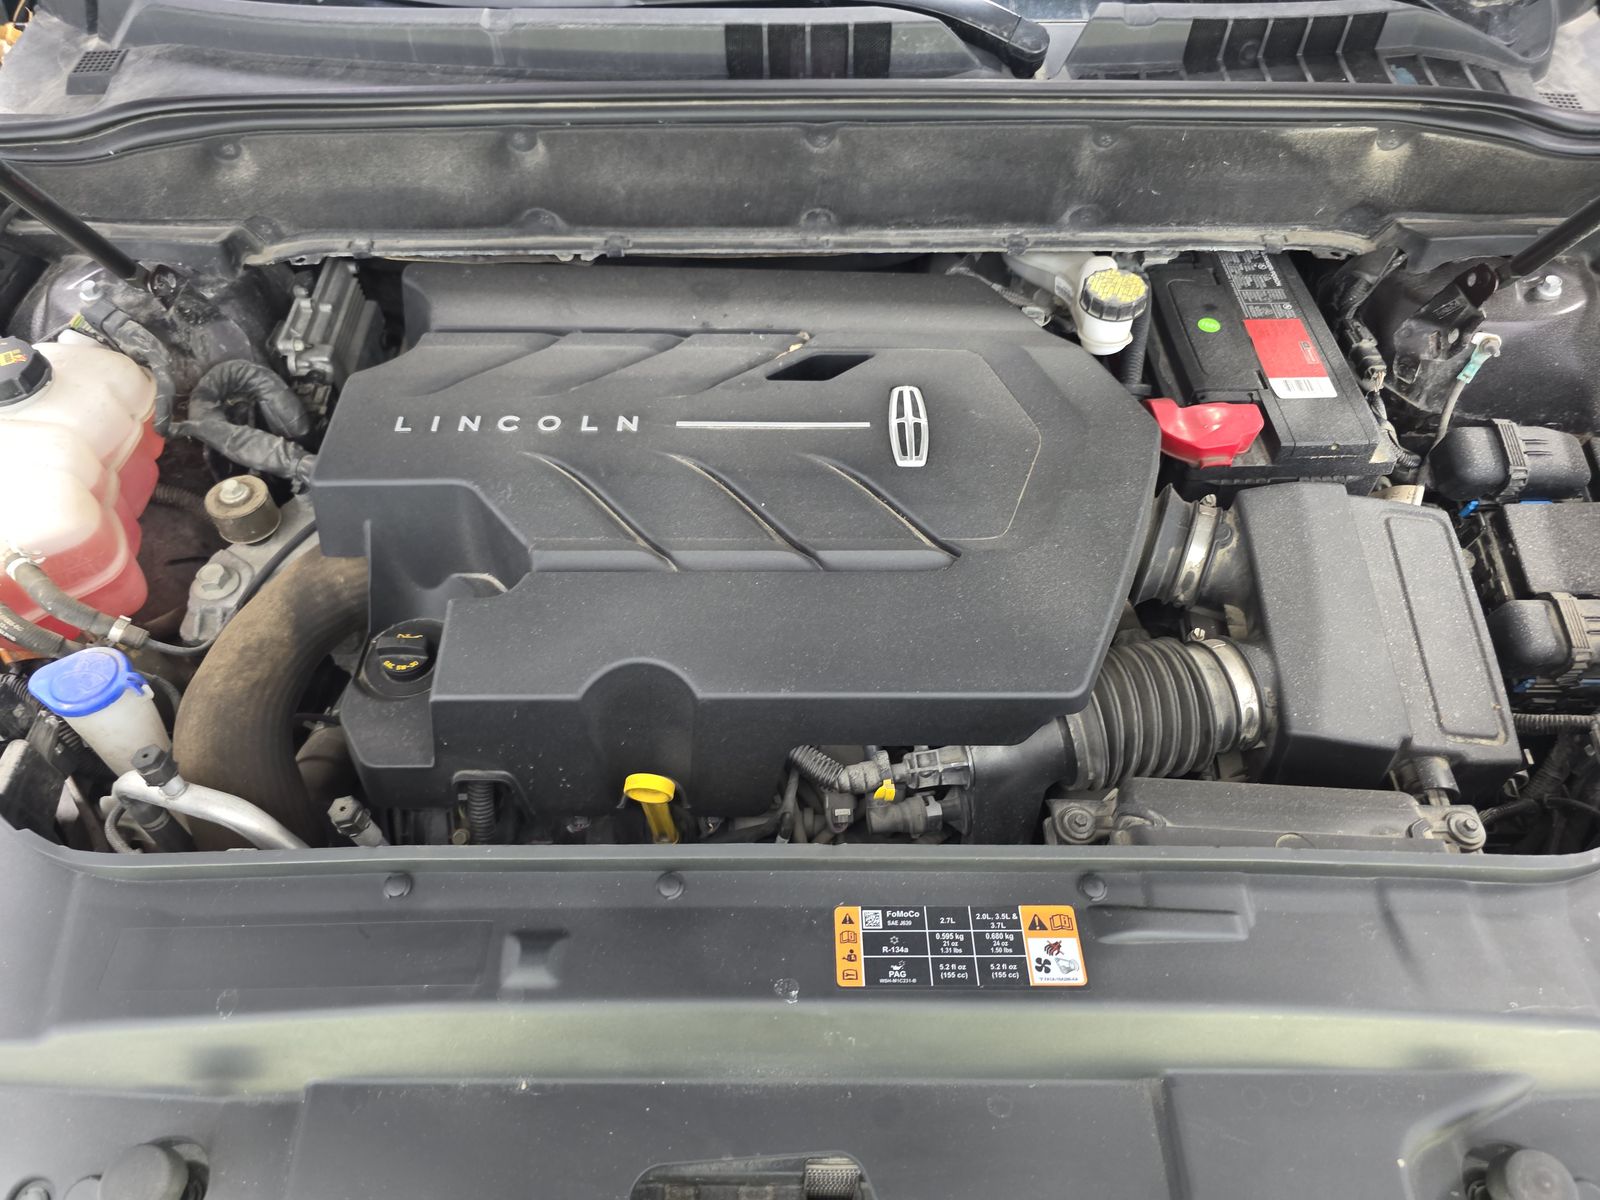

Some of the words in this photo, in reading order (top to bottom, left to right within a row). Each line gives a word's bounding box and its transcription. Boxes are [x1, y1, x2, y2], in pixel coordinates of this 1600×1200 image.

[394, 415, 640, 432] LINCOLN
[955, 933, 964, 941] kg
[1005, 933, 1014, 941] kg
